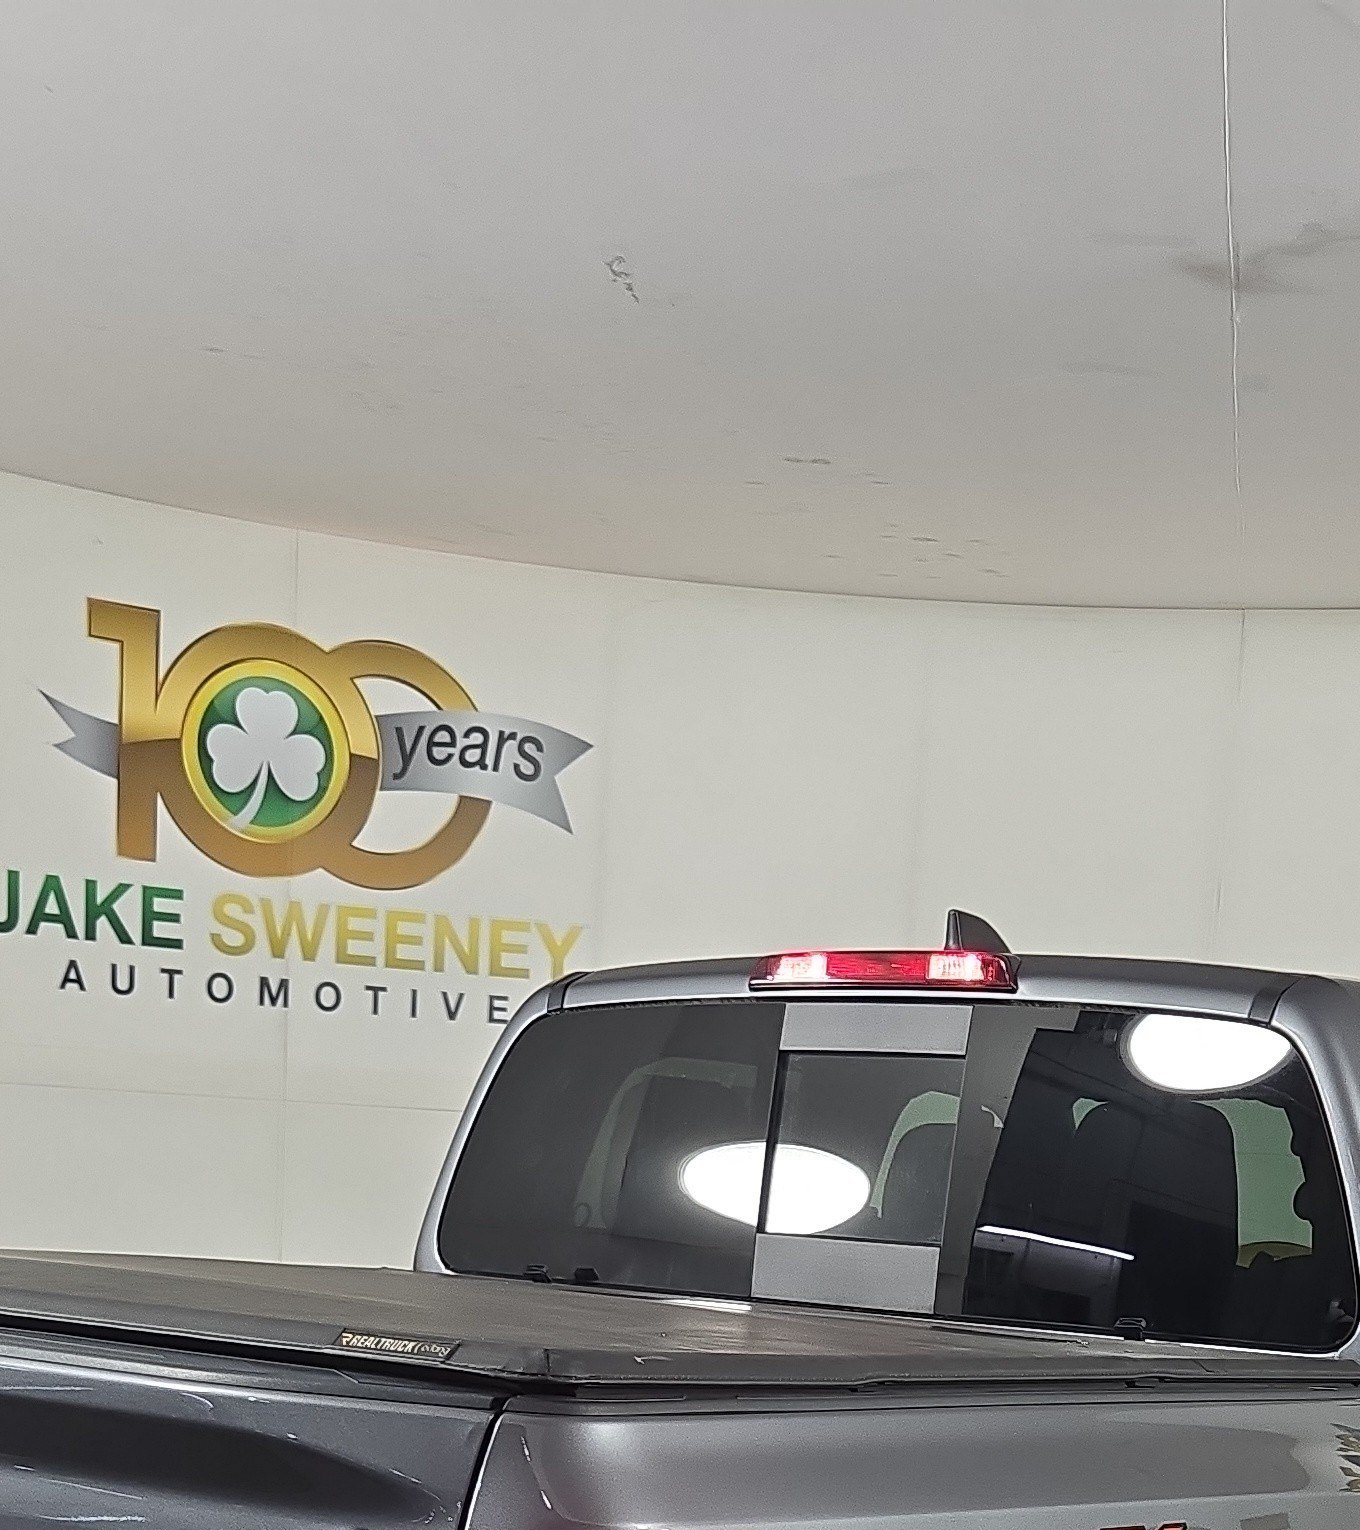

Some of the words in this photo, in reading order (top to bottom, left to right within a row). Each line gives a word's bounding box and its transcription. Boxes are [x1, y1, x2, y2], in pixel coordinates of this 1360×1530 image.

[87, 597, 496, 890] 100
[392, 720, 544, 782] years
[210, 893, 582, 980] SWEENEY
[60, 959, 510, 1024] AUTOMOTIVE
[349, 1334, 417, 1354] REALTRUCK
